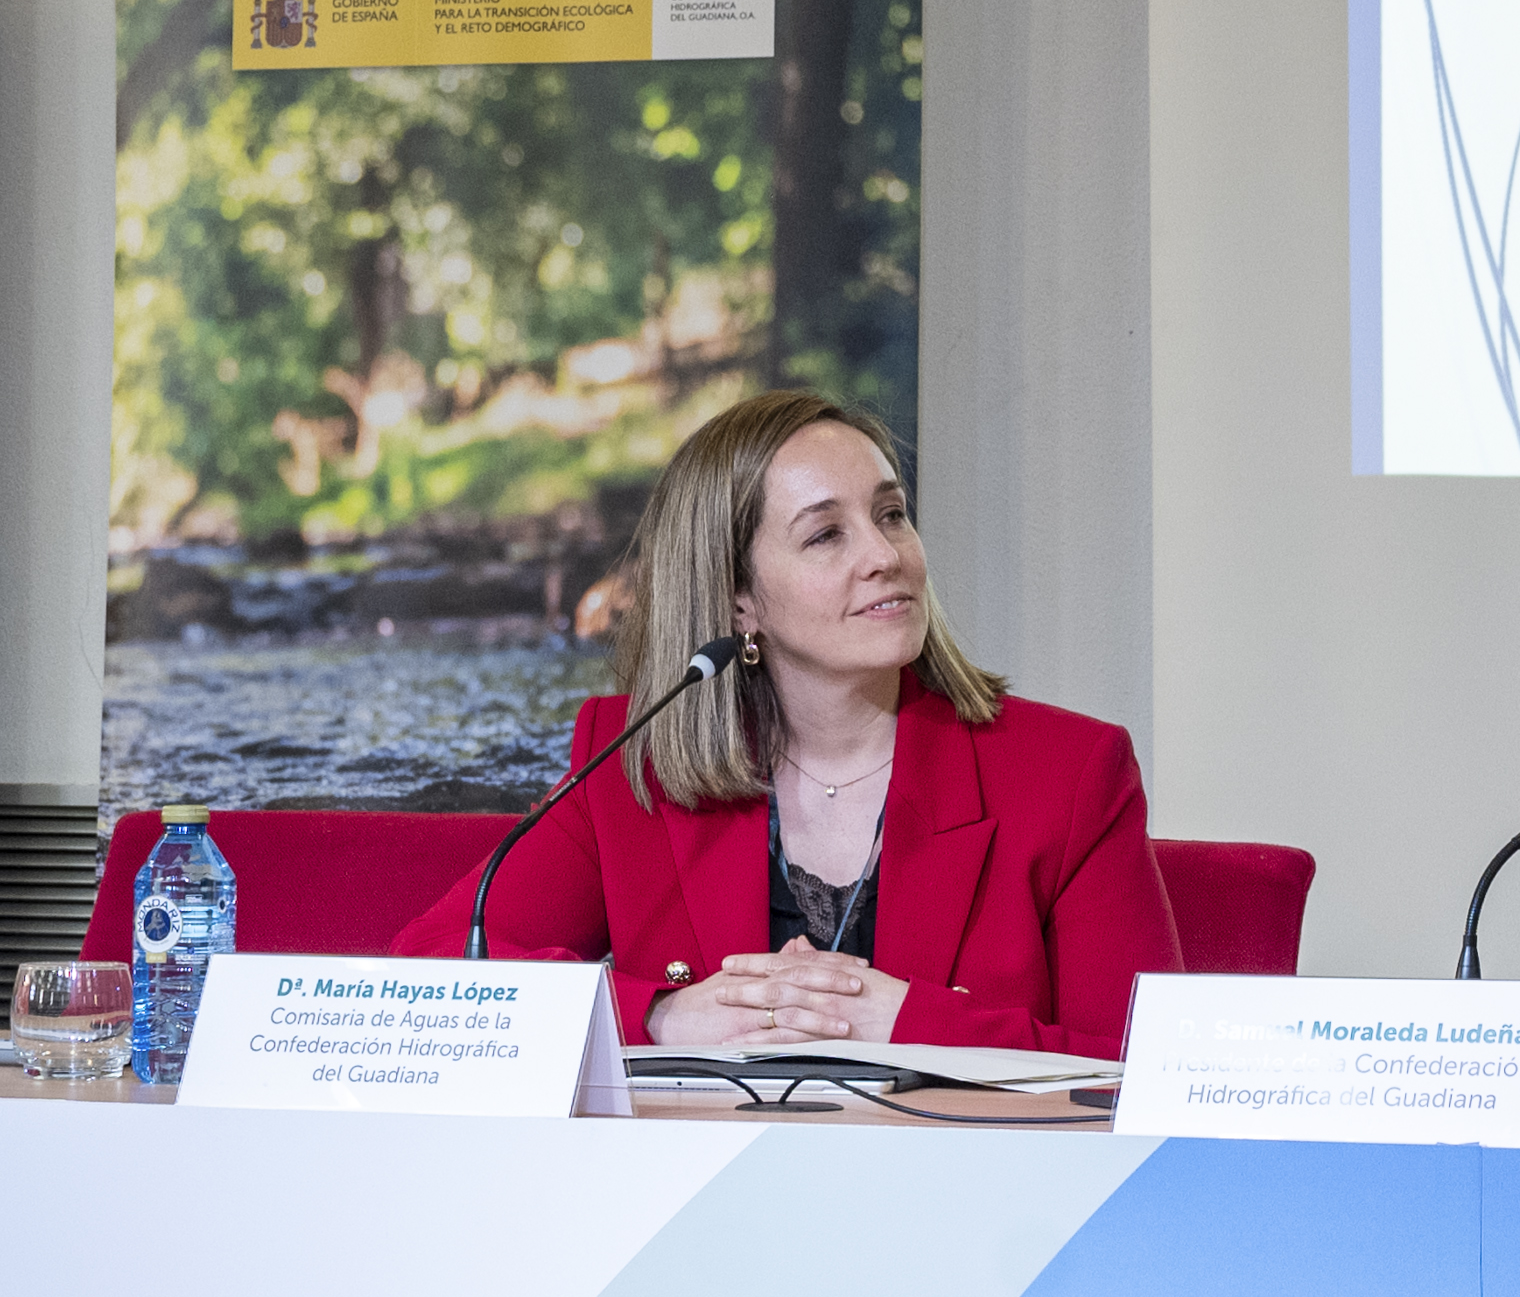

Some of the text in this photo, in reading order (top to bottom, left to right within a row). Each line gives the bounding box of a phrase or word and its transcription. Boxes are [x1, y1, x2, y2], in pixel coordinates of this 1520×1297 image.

[332, 8, 398, 23] DE ESPAÑA
[137, 898, 180, 933] MONDARIZ
[277, 978, 519, 1006] Dª. María Hayas López
[271, 1007, 511, 1032] Comisaria de Aguas de la
[1310, 1020, 1428, 1043] Moraleda
[250, 1034, 519, 1061] Confederación Hidrográfica
[313, 1065, 439, 1084] del Guadiana
[1187, 1084, 1497, 1110] Hidrográfica del Guadiana
